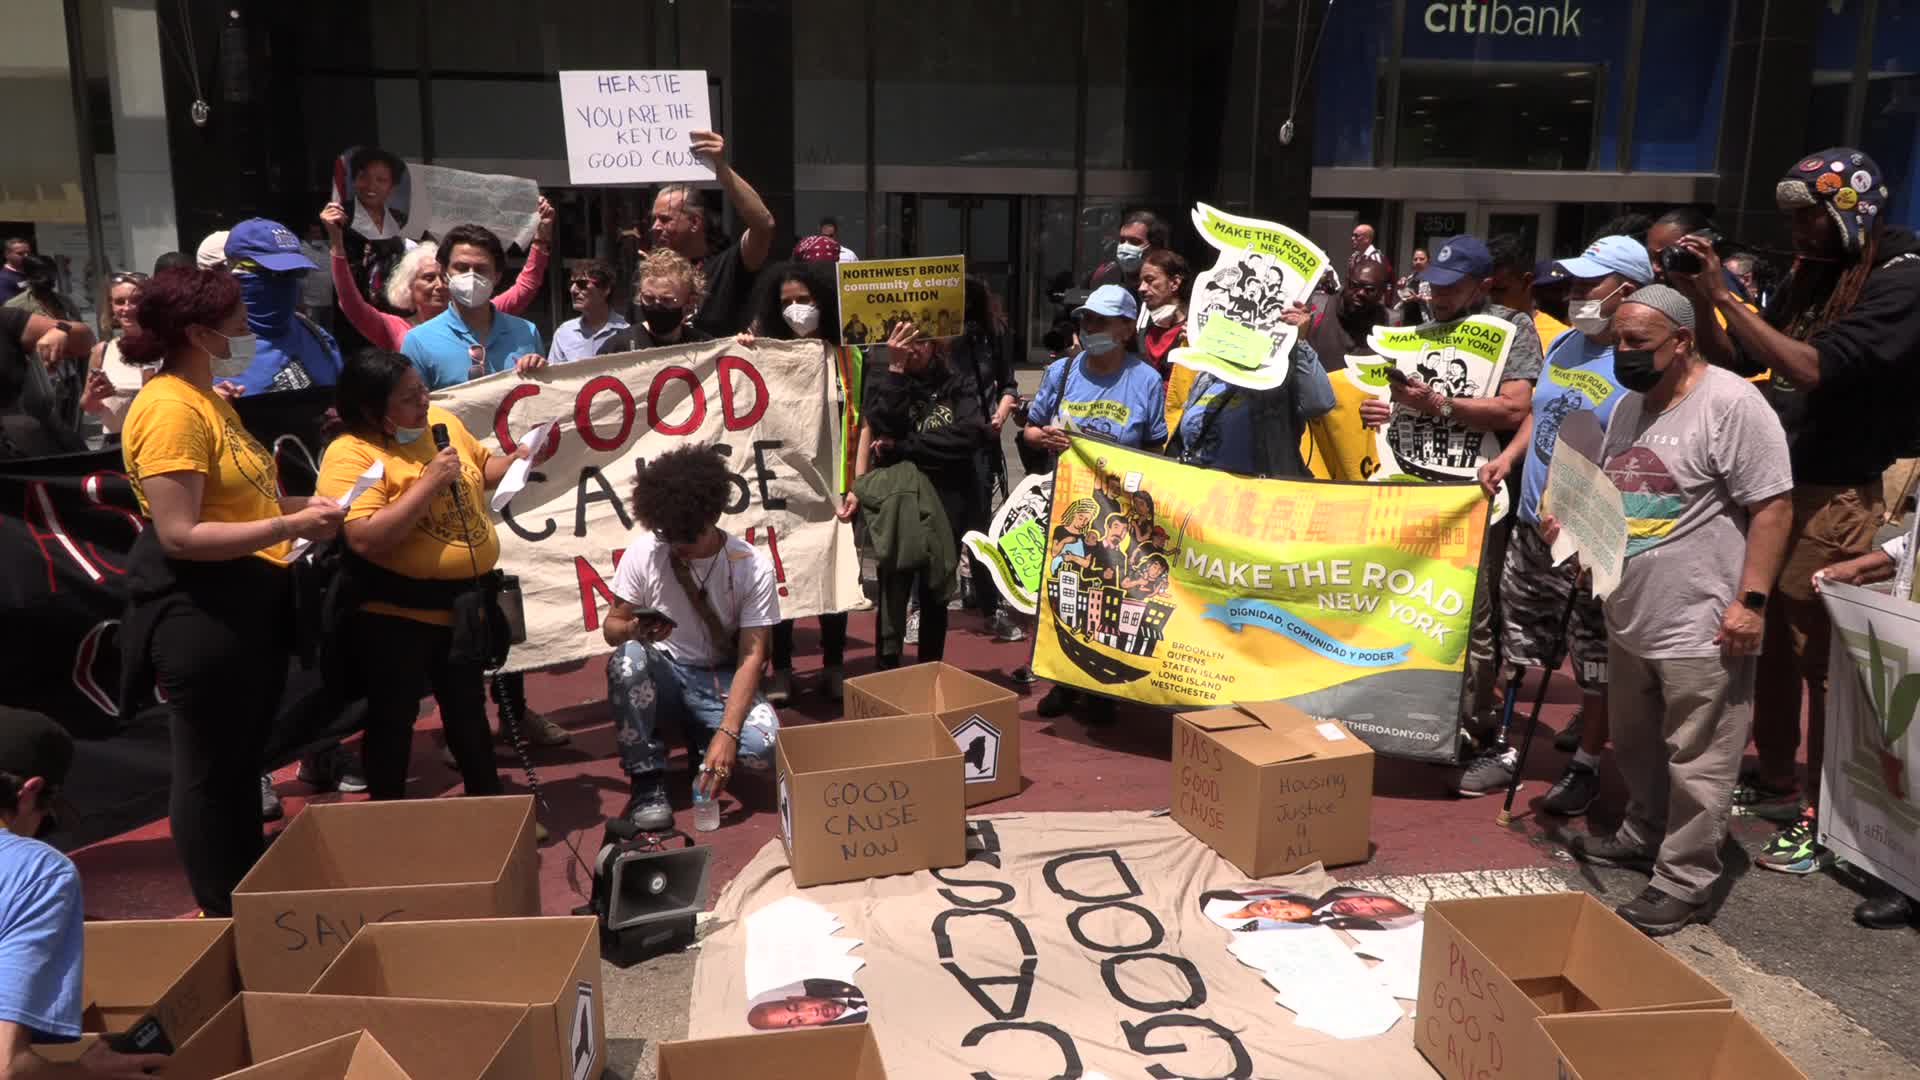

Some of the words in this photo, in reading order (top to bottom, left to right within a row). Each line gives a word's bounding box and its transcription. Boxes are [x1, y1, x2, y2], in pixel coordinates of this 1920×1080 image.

[1424, 0, 1581, 36] citibank
[598, 74, 681, 94] HEASTIE
[577, 105, 623, 128] YOU
[628, 104, 662, 124] ARE
[665, 103, 696, 120] THE
[617, 127, 652, 145] KEY
[655, 127, 678, 141] TO
[588, 150, 643, 169] GOOD
[1214, 221, 1251, 240] MAKE
[1255, 230, 1281, 244] THE
[1283, 238, 1317, 268] ROAD
[1260, 242, 1287, 256] NEW
[1287, 252, 1311, 275] YORK
[843, 266, 916, 279] NORTHWEST
[919, 263, 960, 275] BRONX
[843, 280, 909, 292] community
[912, 278, 922, 288] &
[925, 277, 961, 288] clergy
[866, 290, 939, 304] COALITION
[1461, 324, 1501, 344] ROAD
[1437, 336, 1464, 346] NEW
[1467, 336, 1498, 357] YORK
[1552, 368, 1572, 381] MAKE
[1572, 373, 1588, 381] THE
[1587, 376, 1609, 395] ROAD
[1090, 402, 1104, 410] THE
[1105, 403, 1128, 417] ROAD
[1184, 547, 1273, 590] MAKE
[1279, 559, 1352, 590] THE
[1362, 562, 1464, 616] ROAD
[1317, 592, 1380, 613] NEW
[1387, 600, 1454, 647] YORK
[1229, 608, 1284, 628] DIGNIDAD,
[1286, 622, 1347, 658] COMUNIDAD
[1349, 651, 1357, 661] Y
[1358, 651, 1395, 662] PODER
[1167, 651, 1206, 666] QUEENS
[1171, 641, 1225, 660] BROOKLYN
[1158, 671, 1184, 683] LONG
[1186, 676, 1222, 691] ISLAND
[1162, 661, 1198, 674] STATEN
[1200, 670, 1236, 684] ISLAND
[1150, 679, 1217, 700] WESTCHESTER
[1181, 726, 1223, 772] PASS
[824, 780, 910, 808] GOOD
[1181, 766, 1220, 802] GOOD
[1279, 774, 1347, 798] Housing
[824, 803, 920, 835] CAUSE
[1180, 791, 1225, 831] CAUSE
[1273, 800, 1338, 823] Justice
[841, 834, 899, 861] NOW
[1285, 842, 1314, 863] ALL
[1042, 849, 1253, 1080] GOOD
[1449, 942, 1504, 1022] PASS
[1433, 981, 1503, 1072] GOOD
